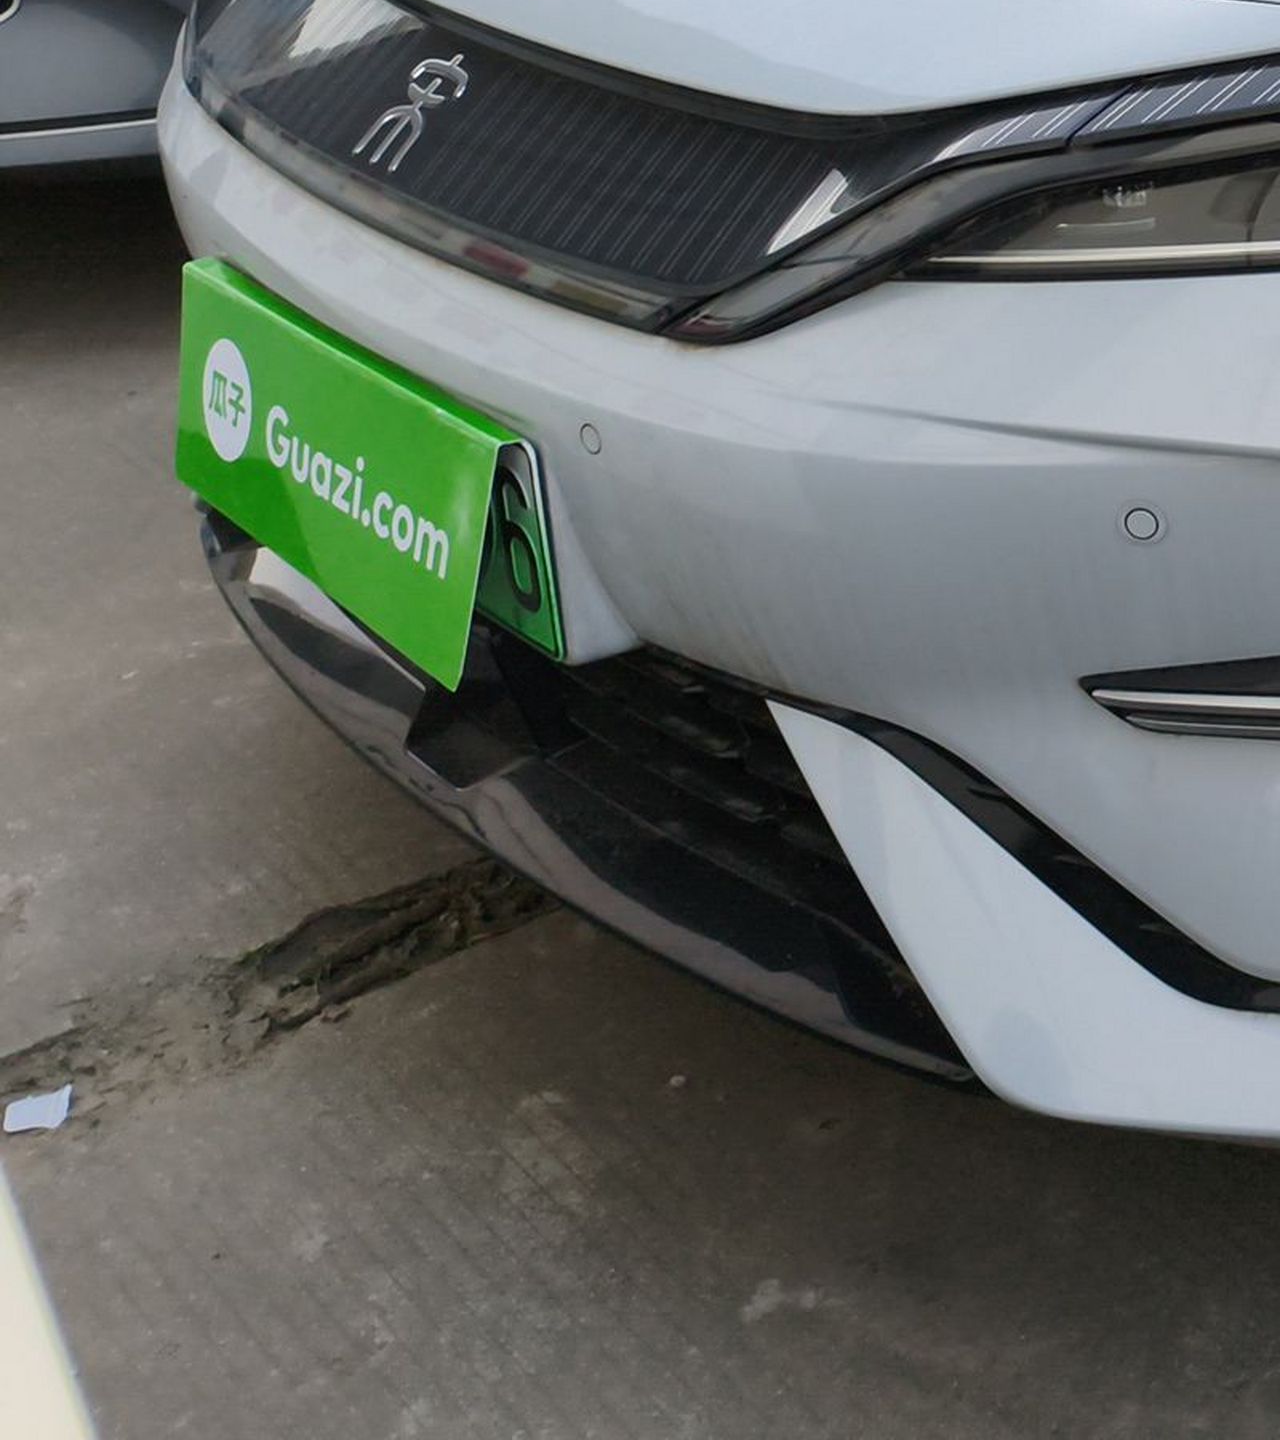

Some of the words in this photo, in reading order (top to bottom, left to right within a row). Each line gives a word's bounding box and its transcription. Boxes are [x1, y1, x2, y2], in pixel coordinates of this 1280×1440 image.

[209, 370, 246, 427] 瓜子
[265, 405, 450, 580] Guazi.com
[482, 465, 542, 612] 6
